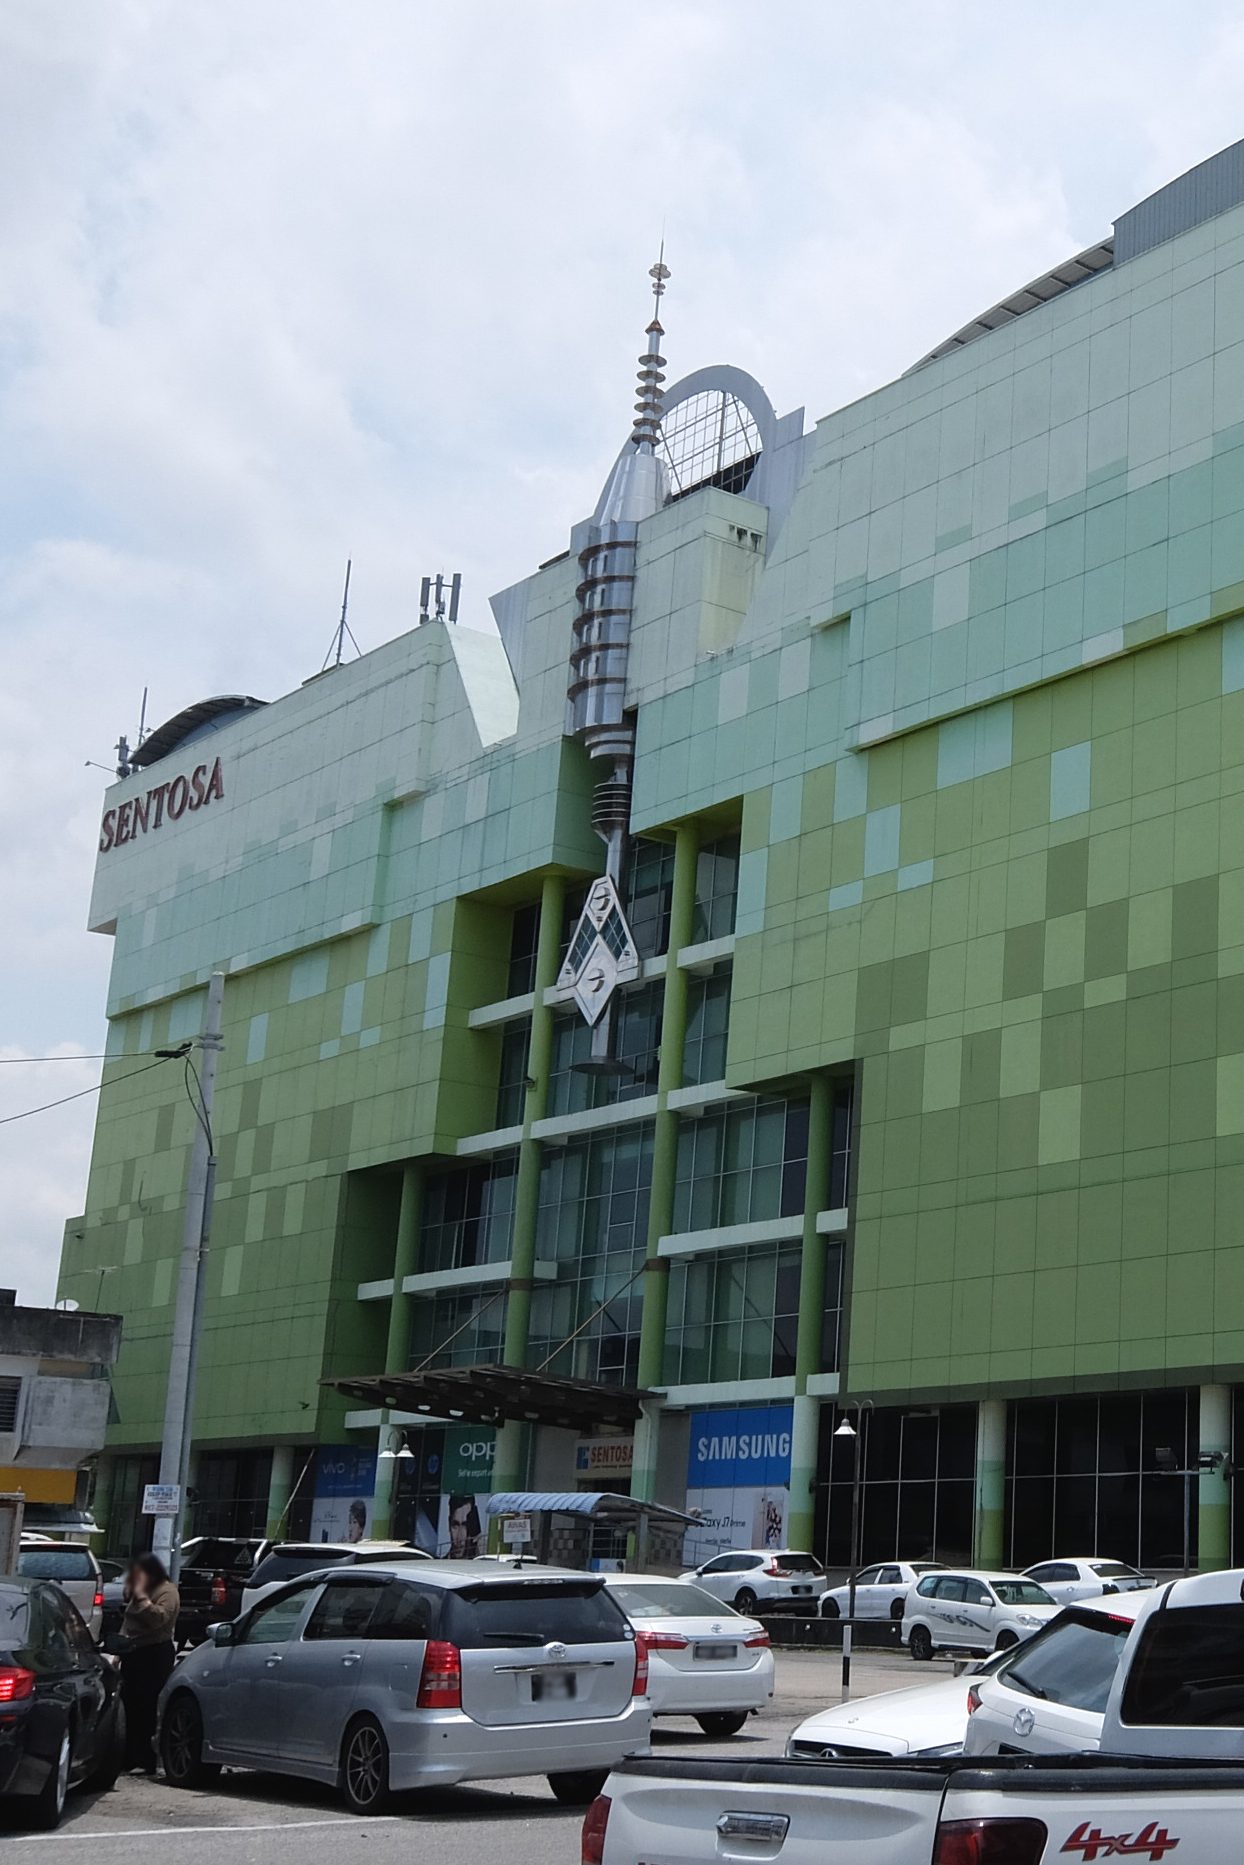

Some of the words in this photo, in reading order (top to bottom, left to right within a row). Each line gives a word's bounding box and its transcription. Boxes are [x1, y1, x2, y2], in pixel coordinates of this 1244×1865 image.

[99, 756, 225, 853] SENTOSA
[459, 1441, 498, 1461] opp
[697, 1432, 791, 1461] SAMSUNG
[1059, 1821, 1182, 1862] 4x4
